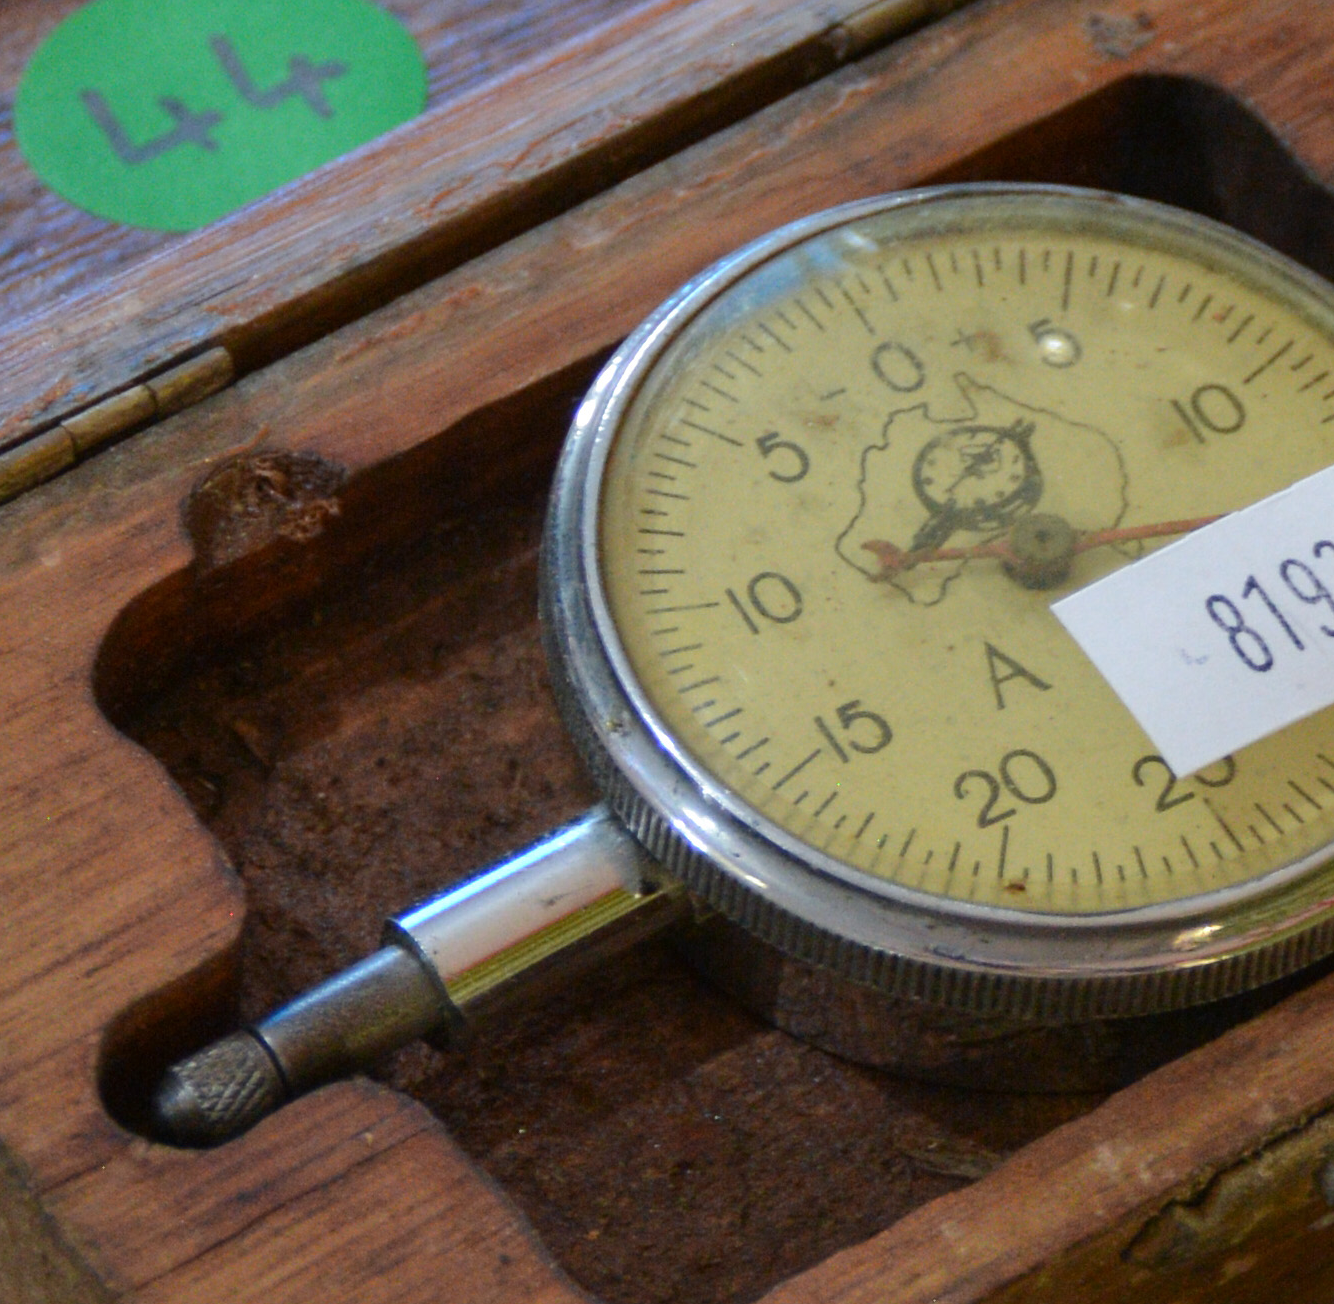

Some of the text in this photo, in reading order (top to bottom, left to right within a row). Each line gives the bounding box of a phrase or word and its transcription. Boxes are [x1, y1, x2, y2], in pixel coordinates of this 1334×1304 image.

[79, 33, 349, 166] 44
[871, 340, 925, 393] 0
[1028, 317, 1082, 369] 5
[1170, 382, 1247, 447] 10
[756, 431, 810, 484] 5
[724, 571, 803, 634] 10
[983, 640, 1053, 711] A
[814, 699, 894, 764] 15
[953, 748, 1058, 829] 20
